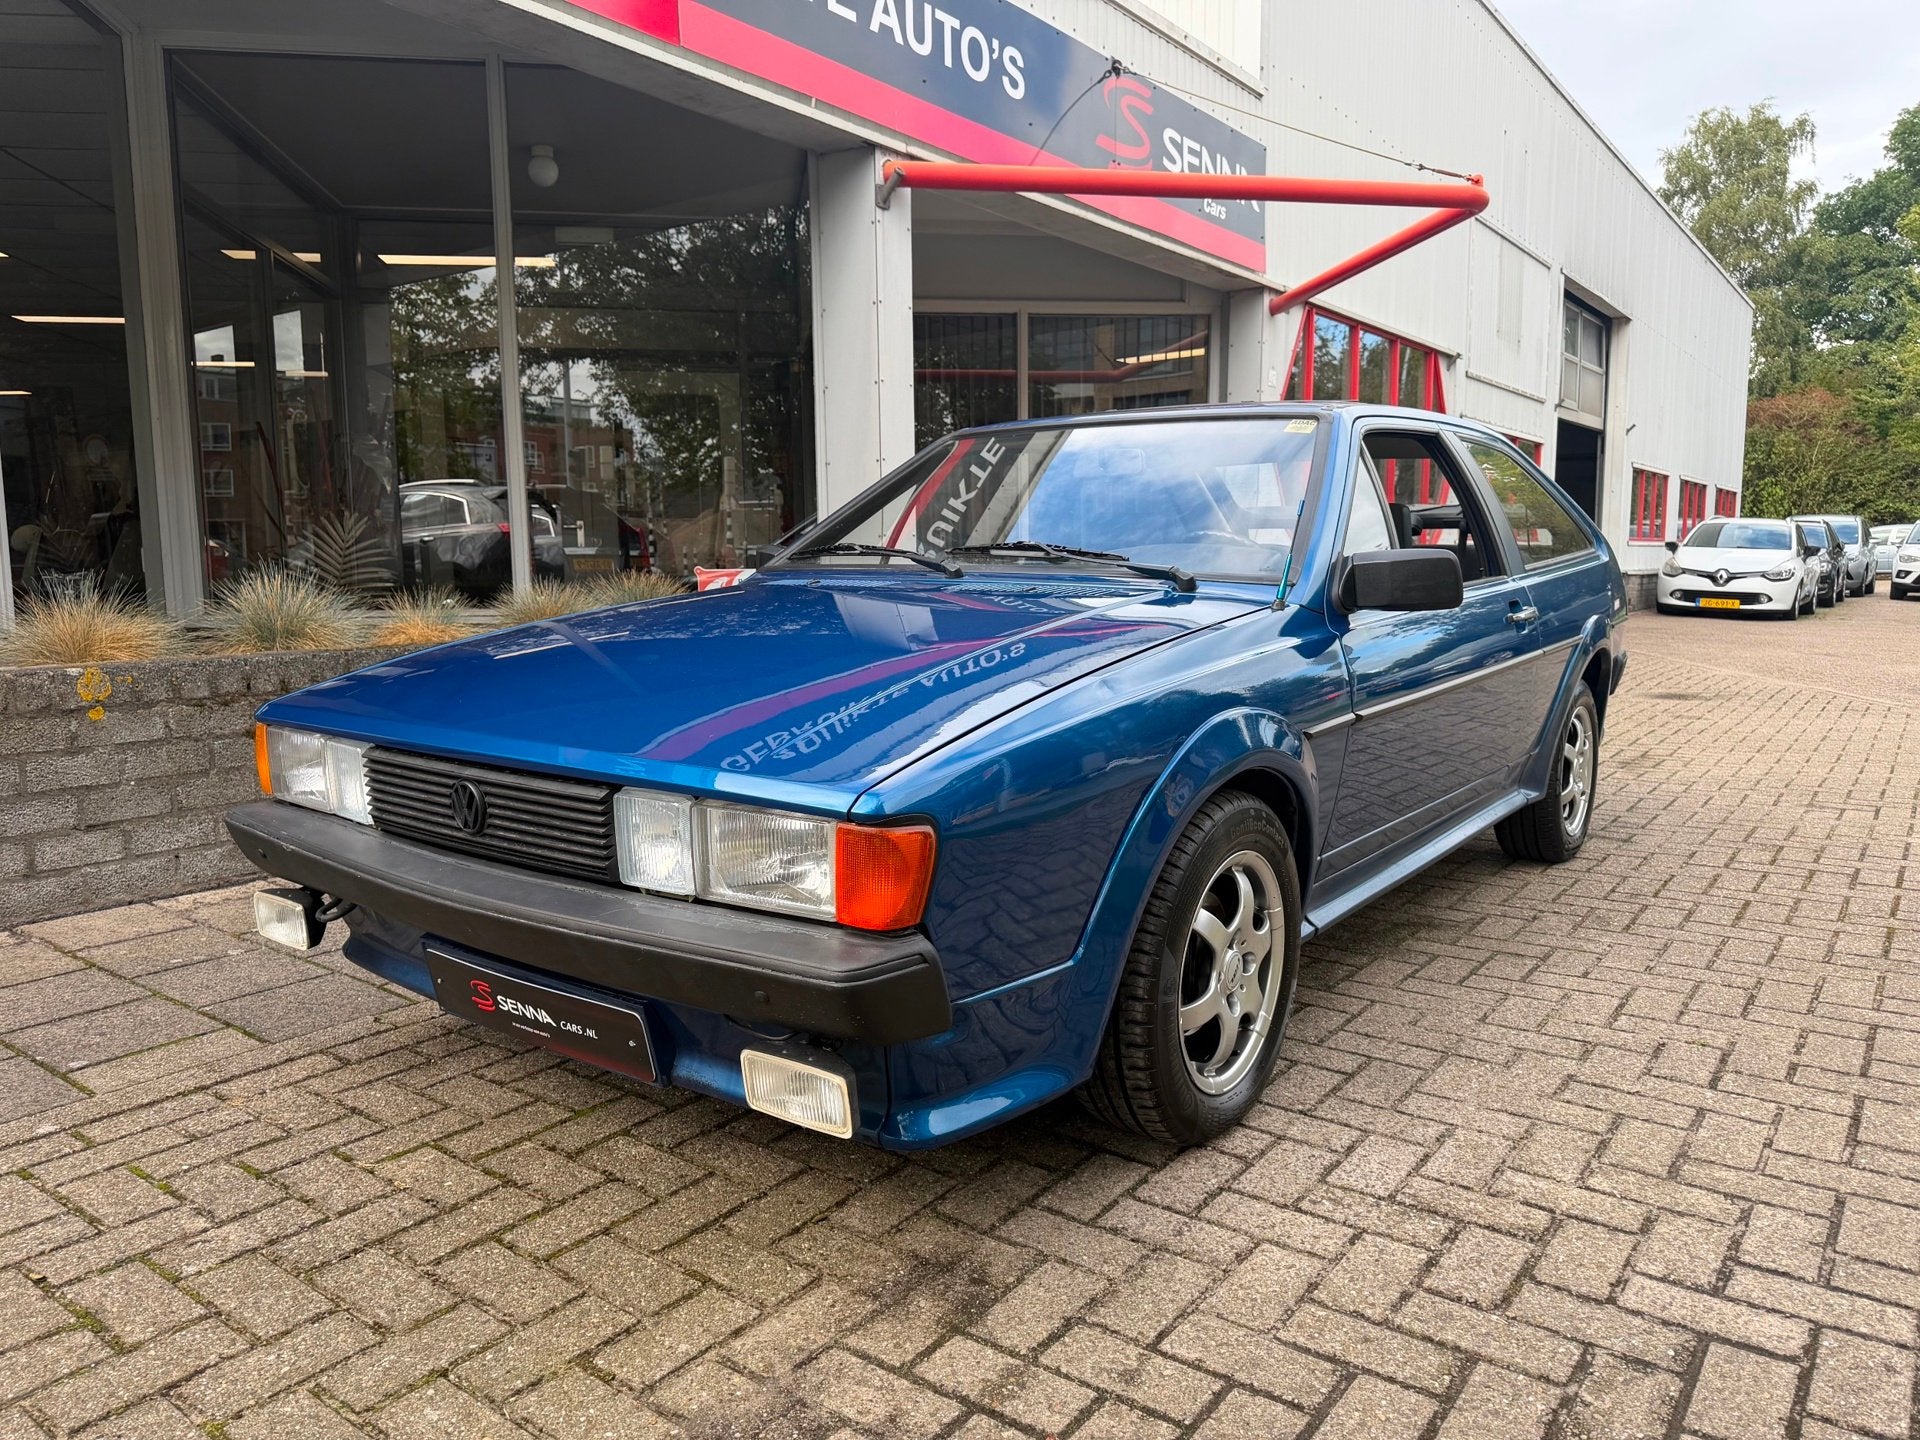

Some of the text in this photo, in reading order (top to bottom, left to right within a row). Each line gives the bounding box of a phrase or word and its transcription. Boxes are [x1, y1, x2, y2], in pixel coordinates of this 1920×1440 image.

[869, 0, 1026, 100] AUTO'S
[1203, 198, 1227, 220] Cars
[496, 995, 557, 1027] SENNA
[560, 1020, 583, 1035] CARS
[584, 1028, 599, 1040] .NL
